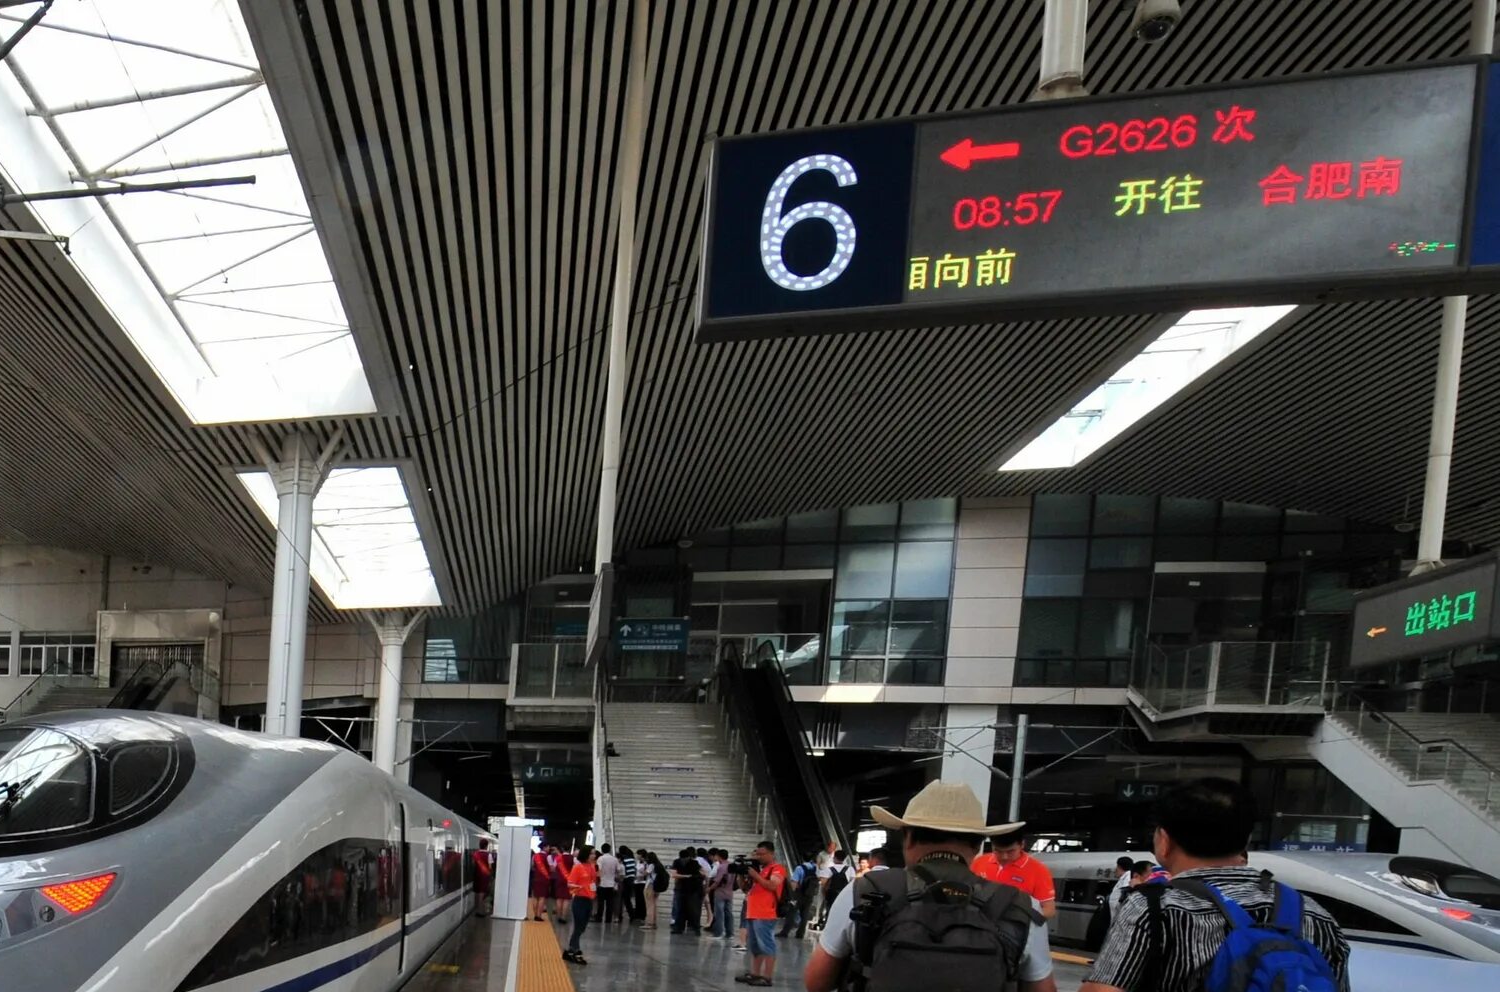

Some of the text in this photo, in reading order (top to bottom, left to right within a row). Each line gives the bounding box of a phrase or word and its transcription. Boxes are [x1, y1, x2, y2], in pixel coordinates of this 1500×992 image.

[1059, 105, 1257, 159] G2626 次
[760, 154, 858, 291] 6
[953, 156, 1402, 231] 08:57 开往 合肥南
[1405, 591, 1477, 637] 出站口
